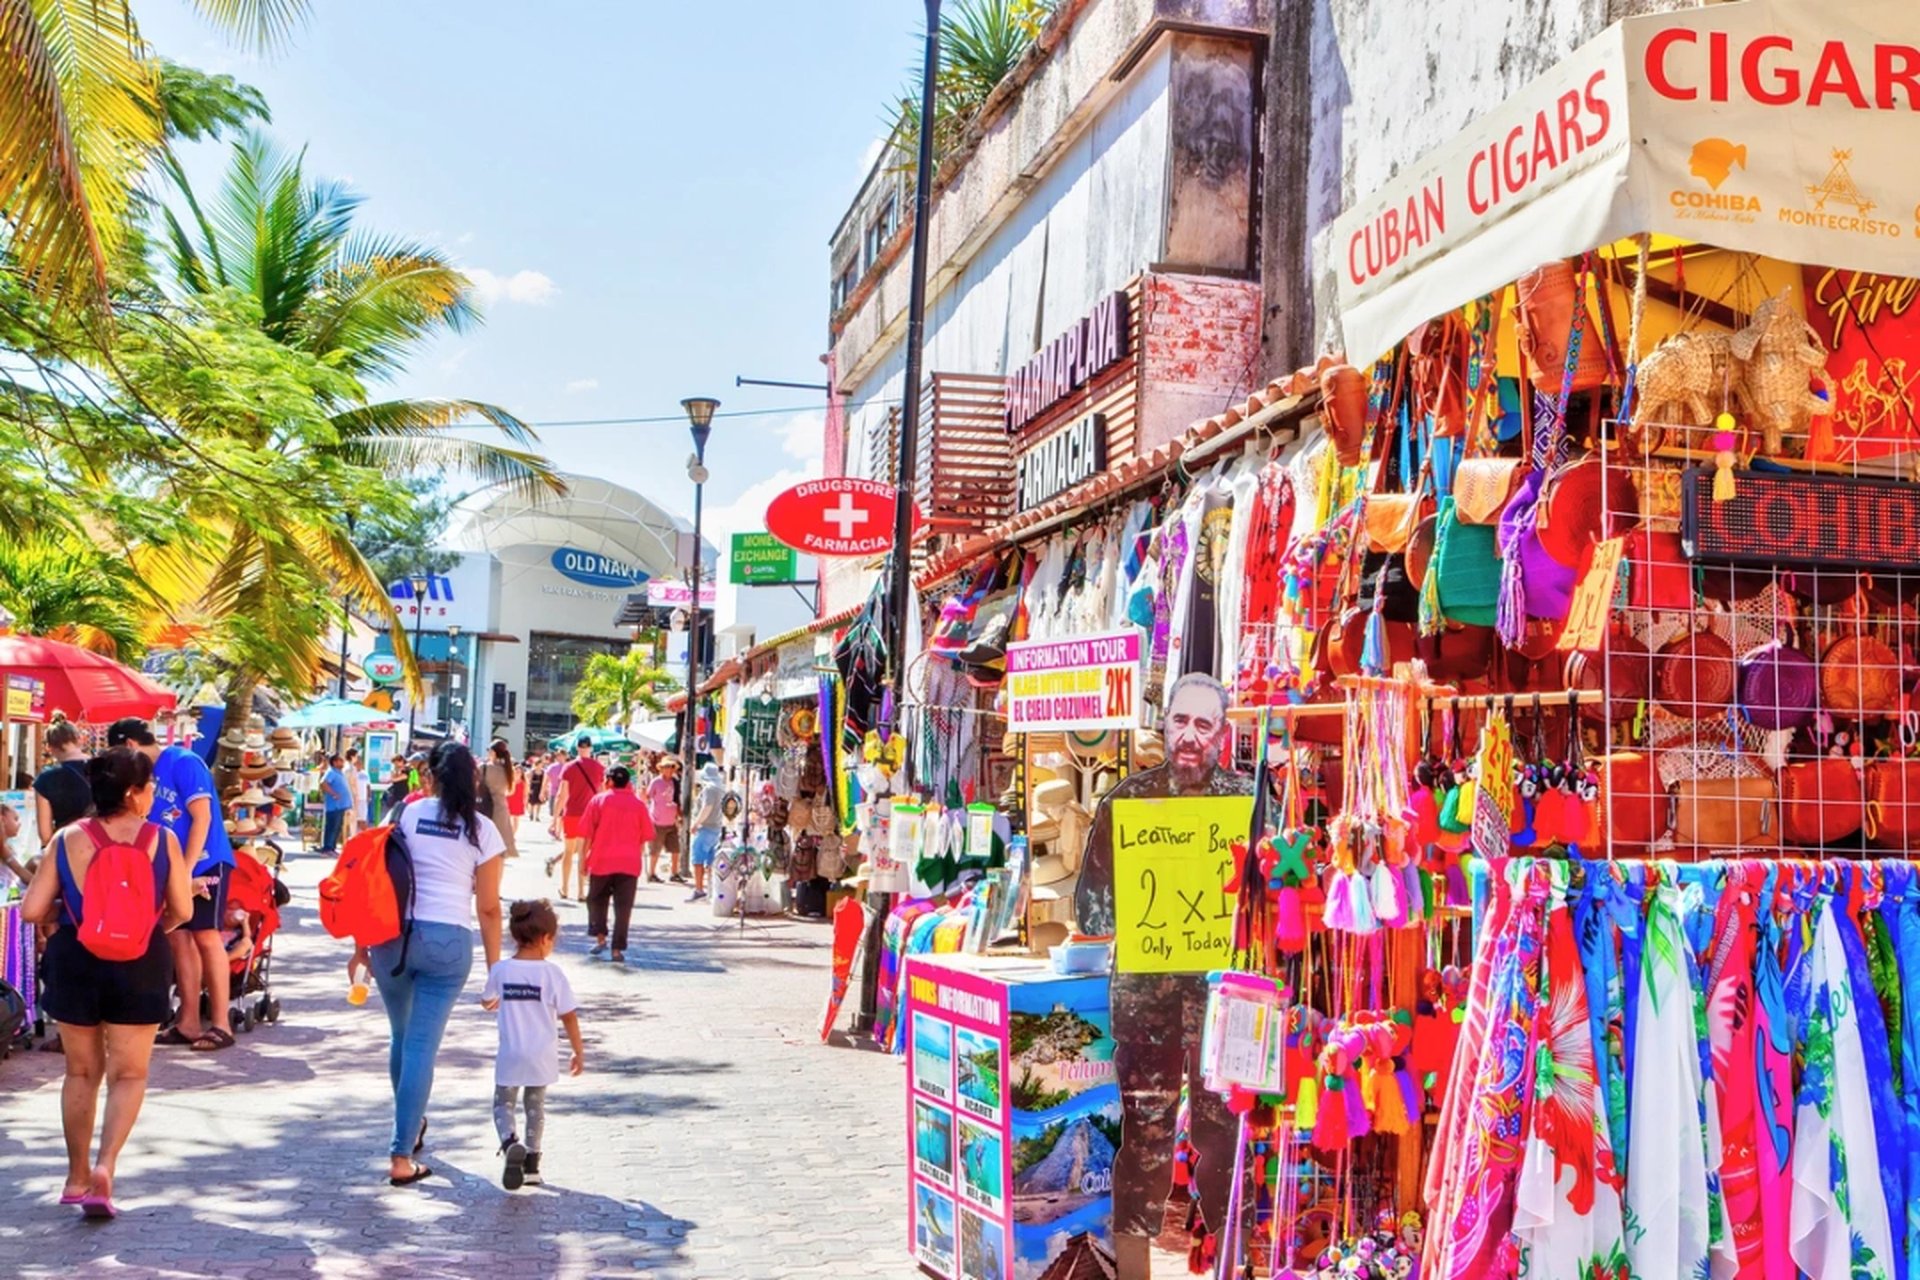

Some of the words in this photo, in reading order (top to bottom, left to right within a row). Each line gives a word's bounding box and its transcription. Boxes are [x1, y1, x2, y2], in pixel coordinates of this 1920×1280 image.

[1349, 175, 1446, 286] CUBAN
[1466, 68, 1612, 217] CIGARS
[1669, 190, 1762, 213] COHIBA
[1777, 207, 1901, 238] MONTECRISTO
[1004, 291, 1121, 433] PHARMAPLAYA
[1016, 413, 1100, 513] FARMACIA
[795, 479, 896, 500] DRUGSTORE
[733, 549, 789, 563] EXCHANGE
[803, 533, 890, 553] FARMACIA
[564, 552, 596, 573] OLD
[1012, 642, 1089, 671] INFORMATION
[1091, 638, 1127, 662] TOUR
[1105, 667, 1132, 717] 2X1
[1014, 700, 1024, 722] EL
[1026, 698, 1052, 721] CIELO
[1053, 695, 1103, 720] COZUMEL
[1136, 868, 1167, 930] 2
[1141, 936, 1173, 961] Only
[1182, 931, 1232, 957] Today
[910, 974, 937, 1006] TOURS
[938, 983, 1001, 1026] INFORMATION
